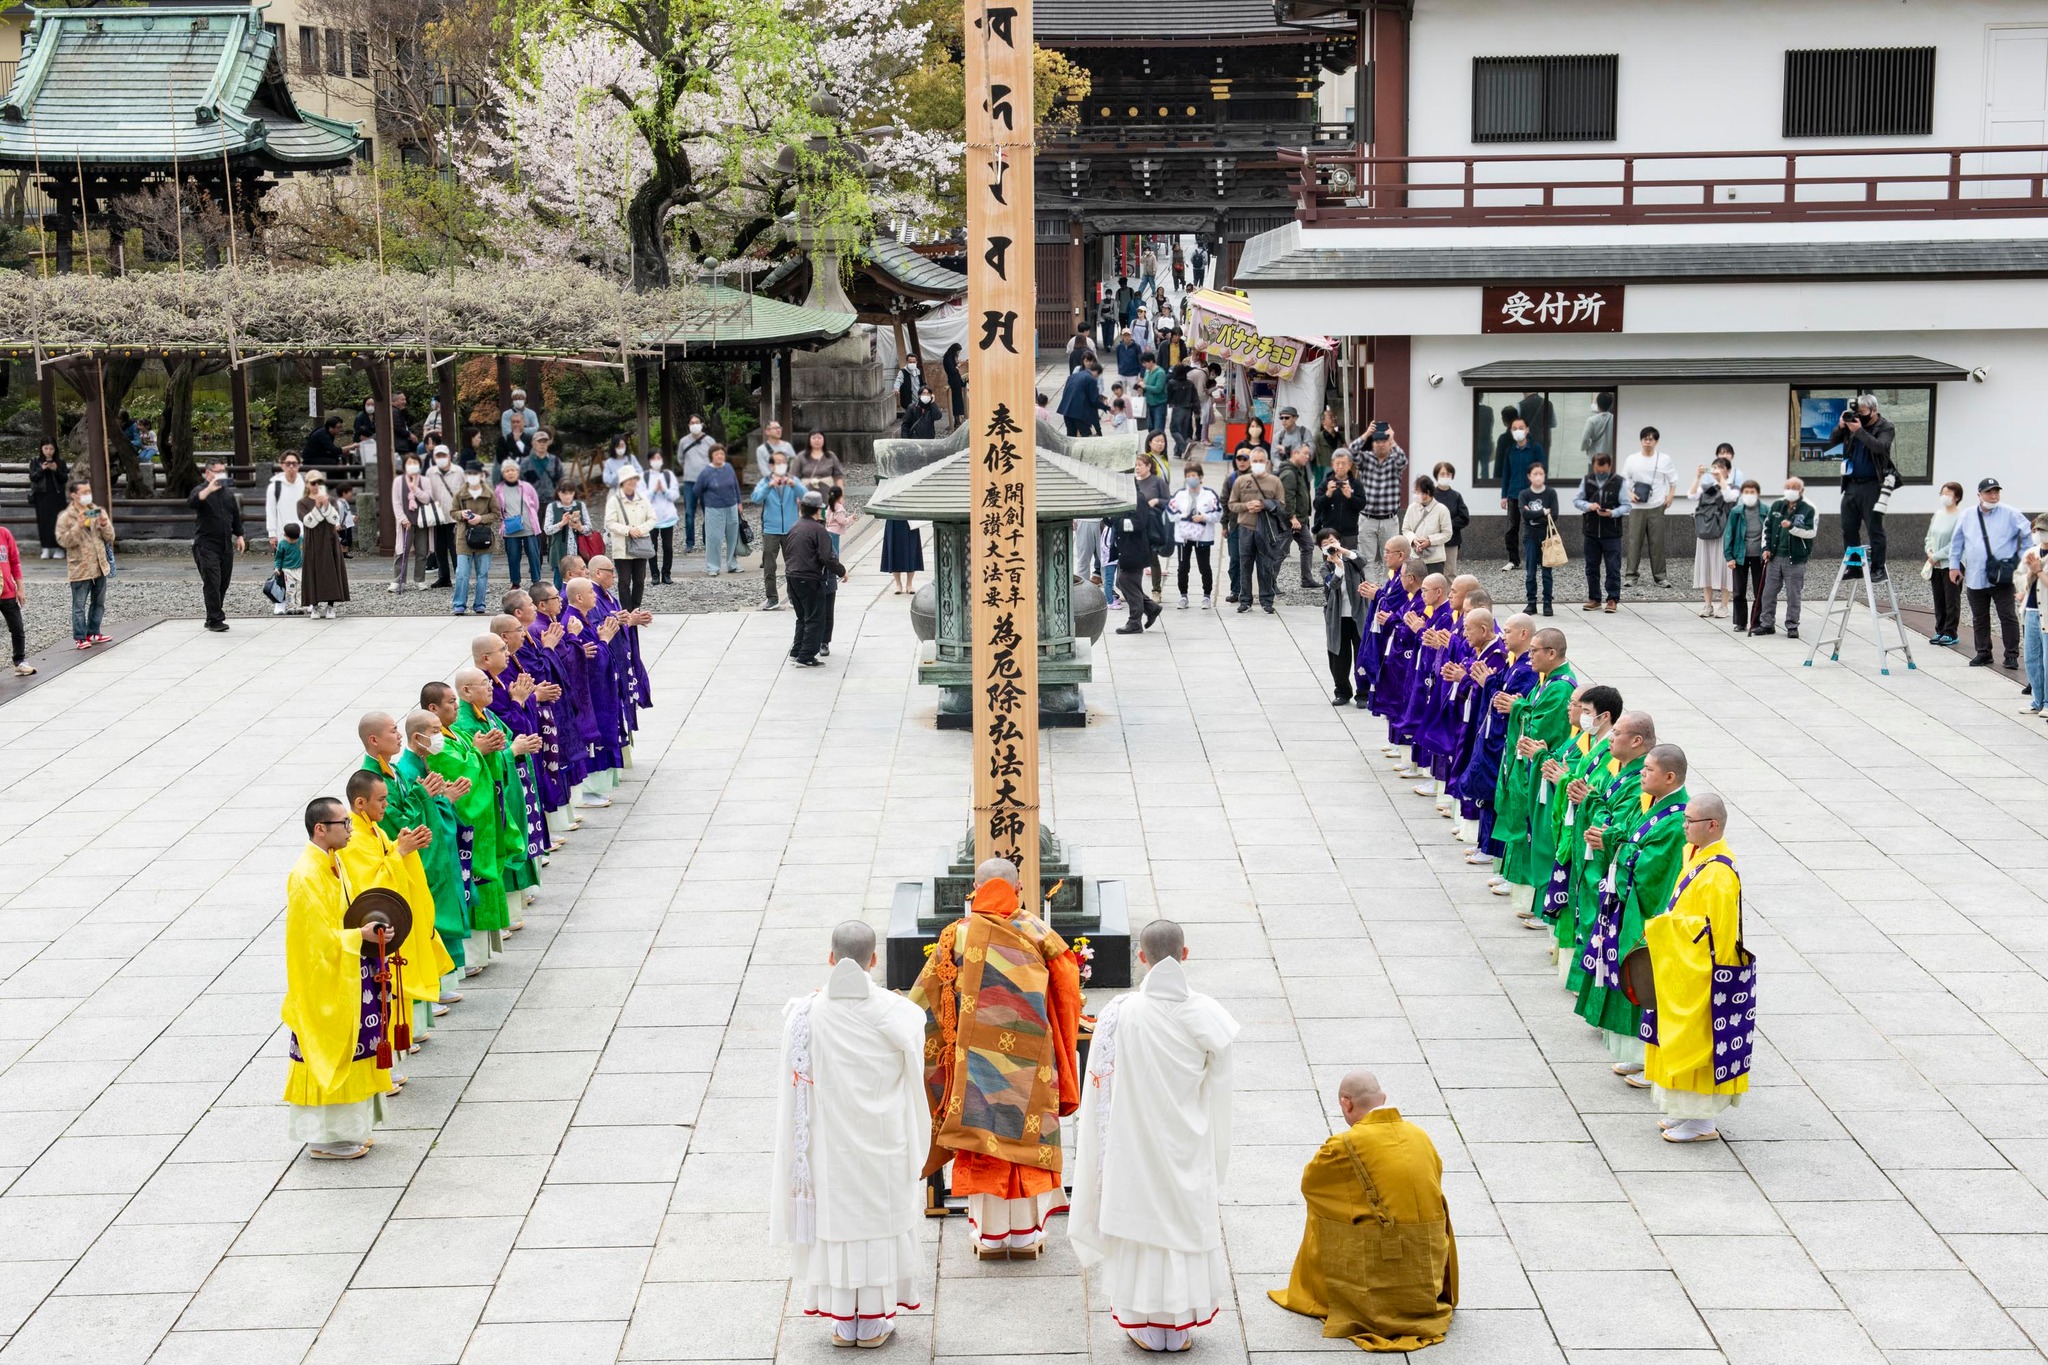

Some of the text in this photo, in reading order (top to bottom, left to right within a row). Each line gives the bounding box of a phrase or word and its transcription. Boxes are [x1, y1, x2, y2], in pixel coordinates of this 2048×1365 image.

[1501, 291, 1607, 326] 受付所
[1216, 324, 1297, 367] バナナチョコ
[983, 403, 1022, 474] 奉修
[1003, 482, 1025, 609] 開創千二百年
